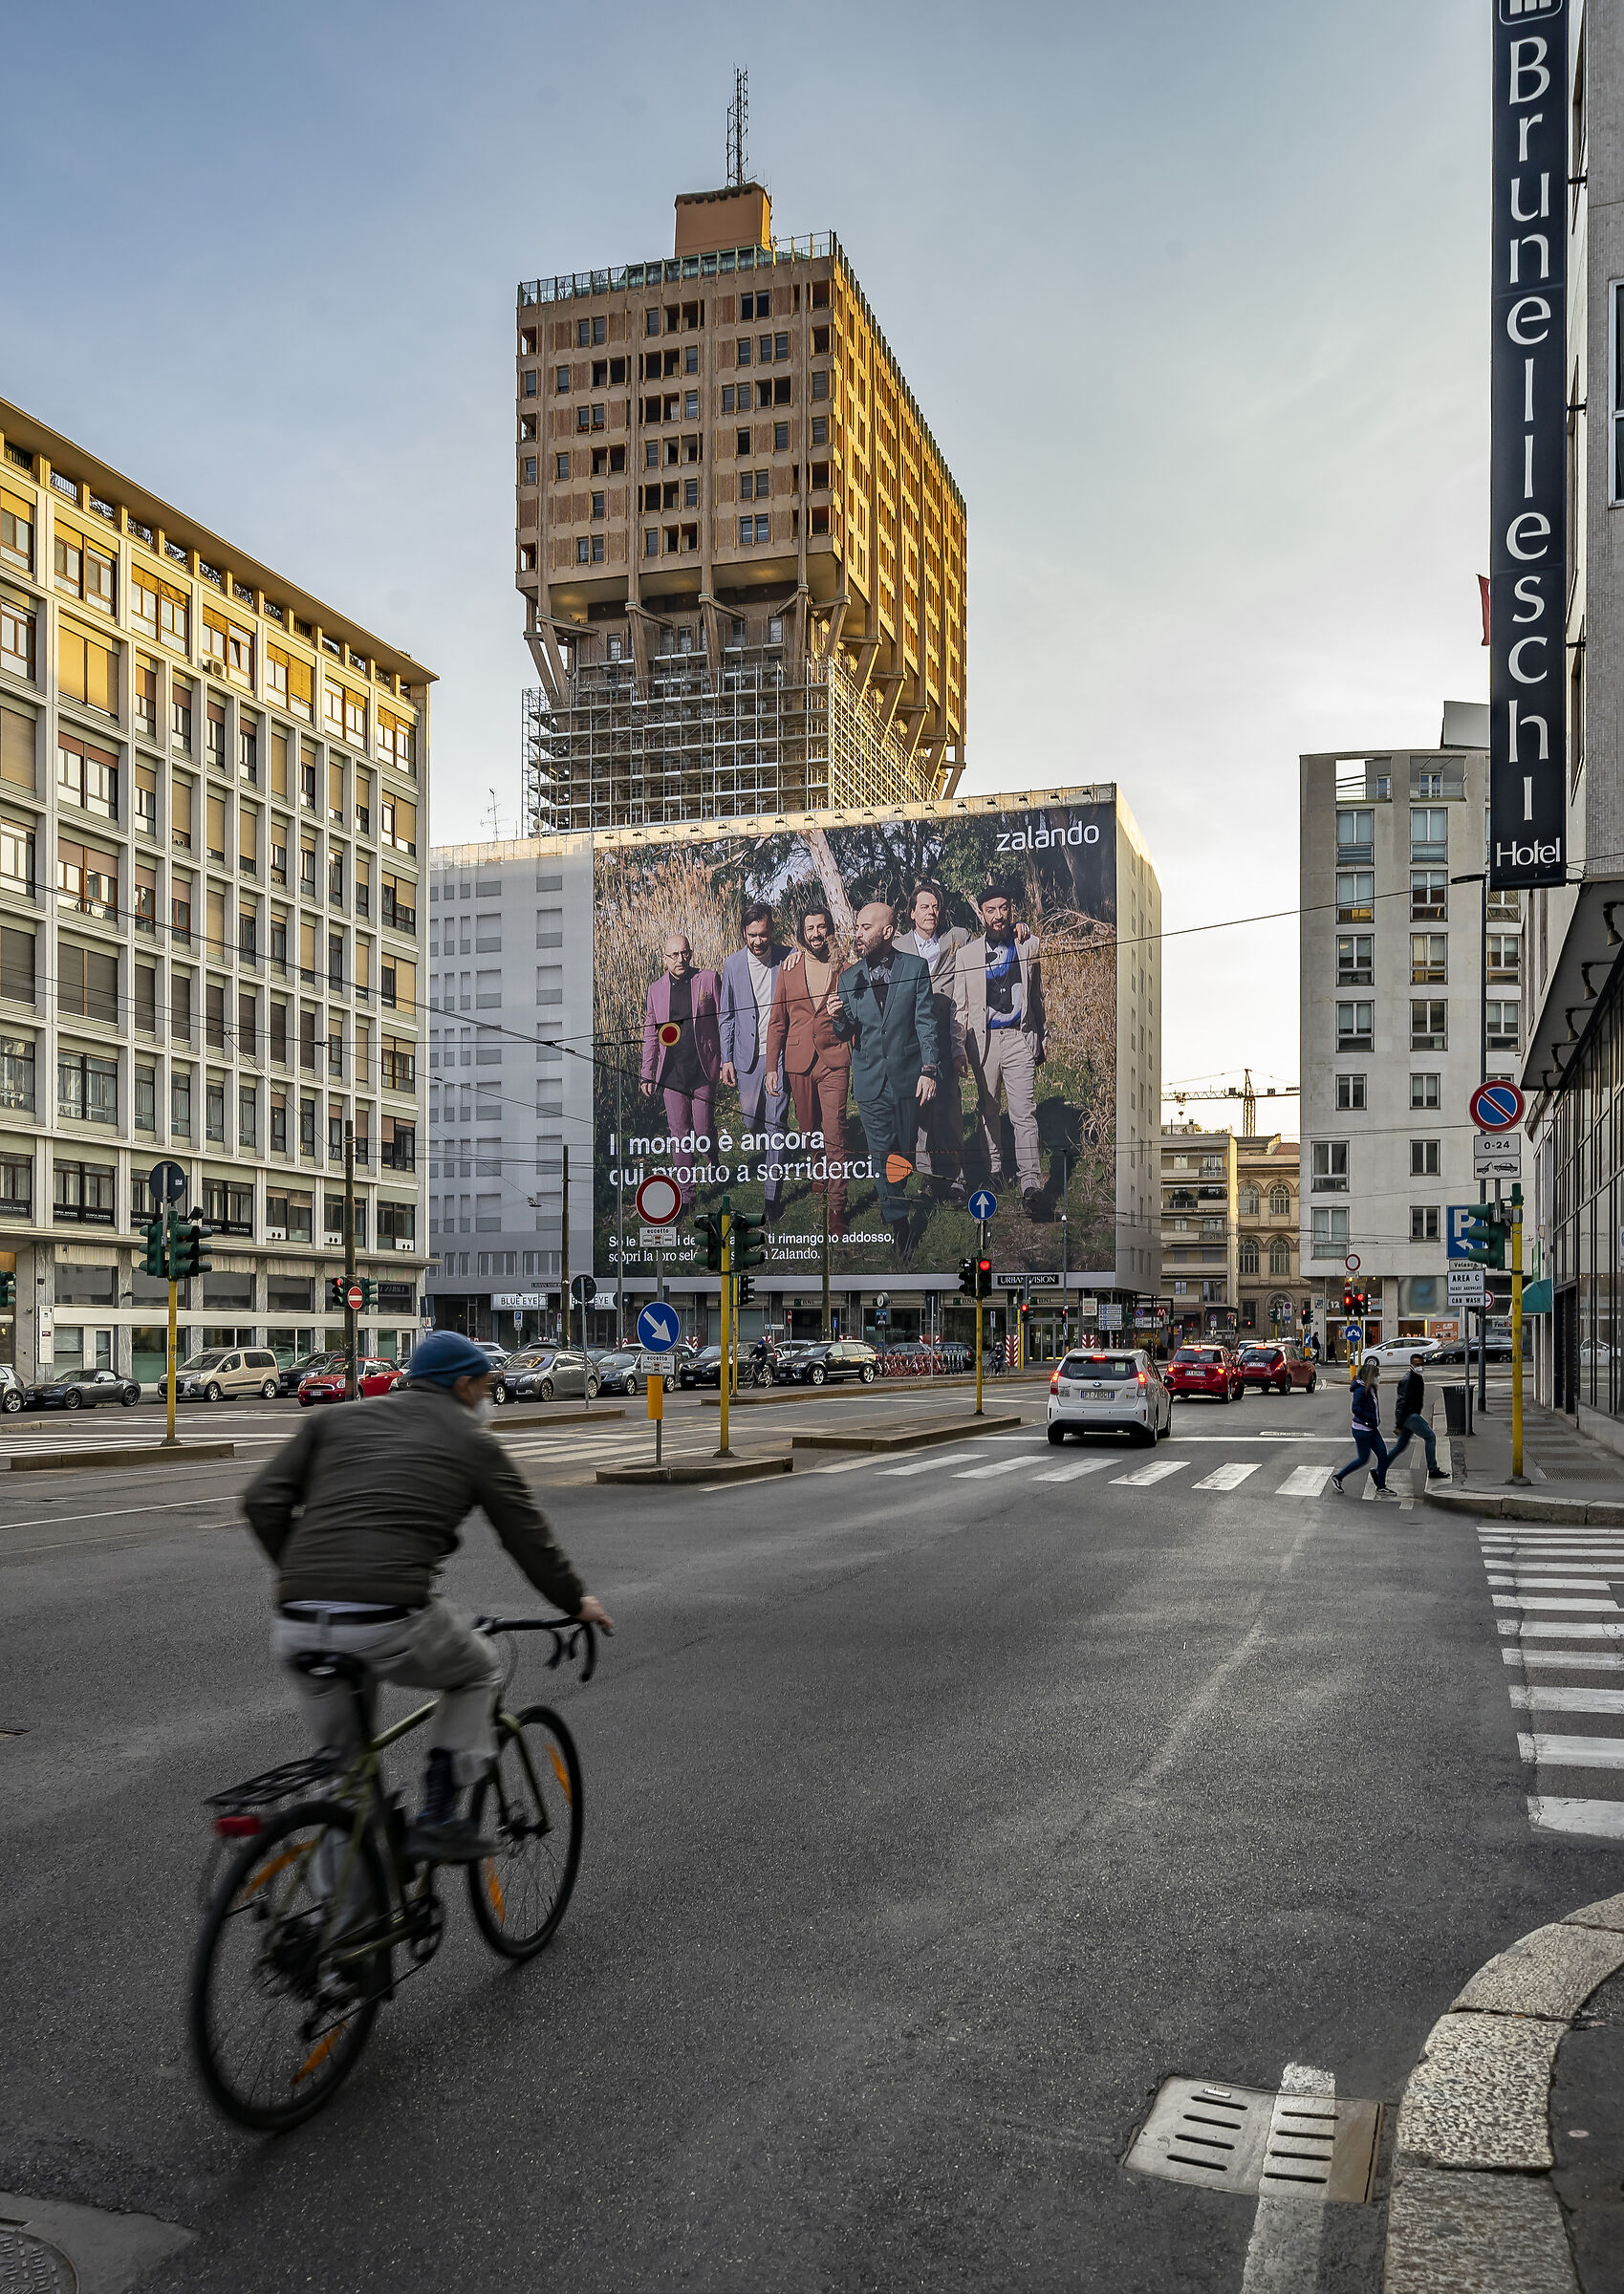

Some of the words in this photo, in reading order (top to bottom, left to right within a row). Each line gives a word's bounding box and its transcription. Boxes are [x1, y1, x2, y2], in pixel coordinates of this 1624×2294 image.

[996, 820, 1100, 852] zalando
[1496, 837, 1561, 867] Hotel
[629, 1131, 711, 1156] mondo
[718, 1129, 733, 1152] è
[741, 1131, 825, 1152] ancora
[1483, 1140, 1510, 1150] 0-24
[609, 1163, 644, 1191] qui
[737, 1164, 750, 1182] a
[756, 1154, 880, 1182] sorriderci.
[1453, 1209, 1477, 1238] P
[626, 1236, 637, 1247] le
[768, 1233, 775, 1244] ti
[841, 1231, 895, 1244] addosso,
[643, 1250, 654, 1262] la
[771, 1246, 821, 1260] Zalando.
[1452, 1274, 1470, 1283] AREA
[501, 1297, 520, 1306] BLUE
[522, 1296, 537, 1305] EYE
